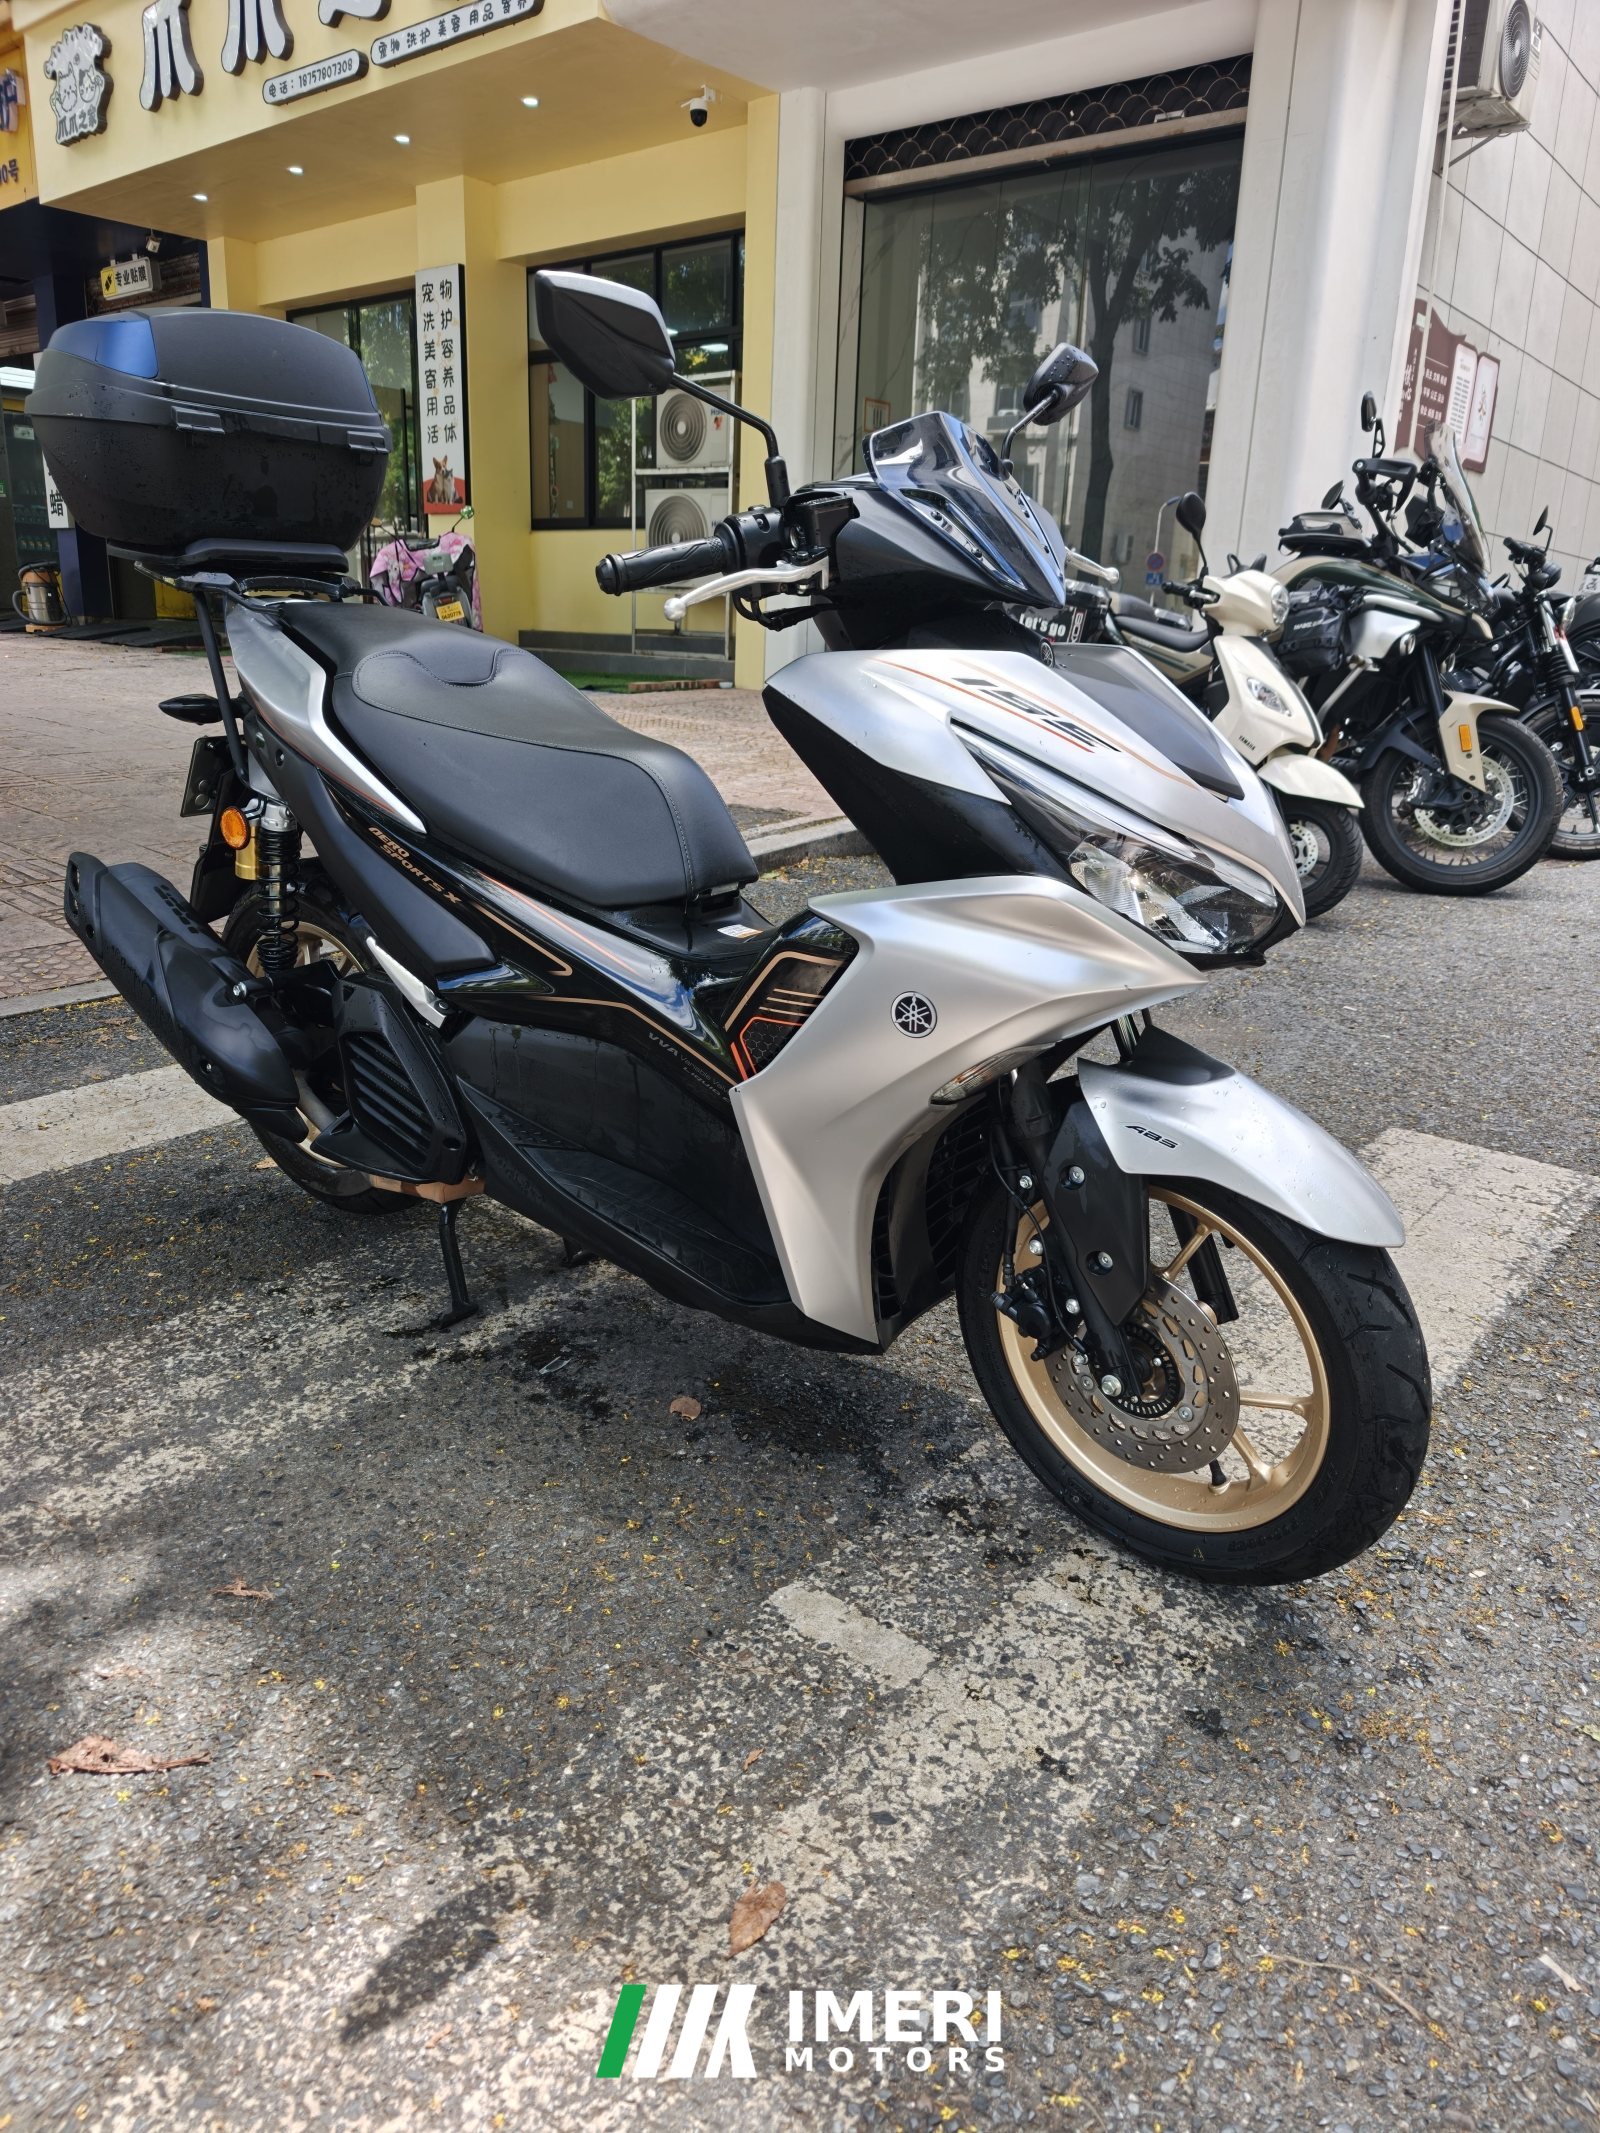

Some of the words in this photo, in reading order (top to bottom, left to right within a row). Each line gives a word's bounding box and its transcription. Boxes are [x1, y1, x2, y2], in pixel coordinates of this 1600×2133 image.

[406, 27, 431, 49] 洗护
[438, 14, 461, 37] 美容
[469, 2, 494, 26] 用品
[115, 264, 147, 287] 专业贴膜
[1019, 613, 1048, 632] Let's
[1048, 622, 1066, 638] go
[380, 844, 445, 892] SPORTS
[443, 891, 462, 904] X
[649, 1032, 678, 1056] VVA
[1125, 1125, 1178, 1149] ABS
